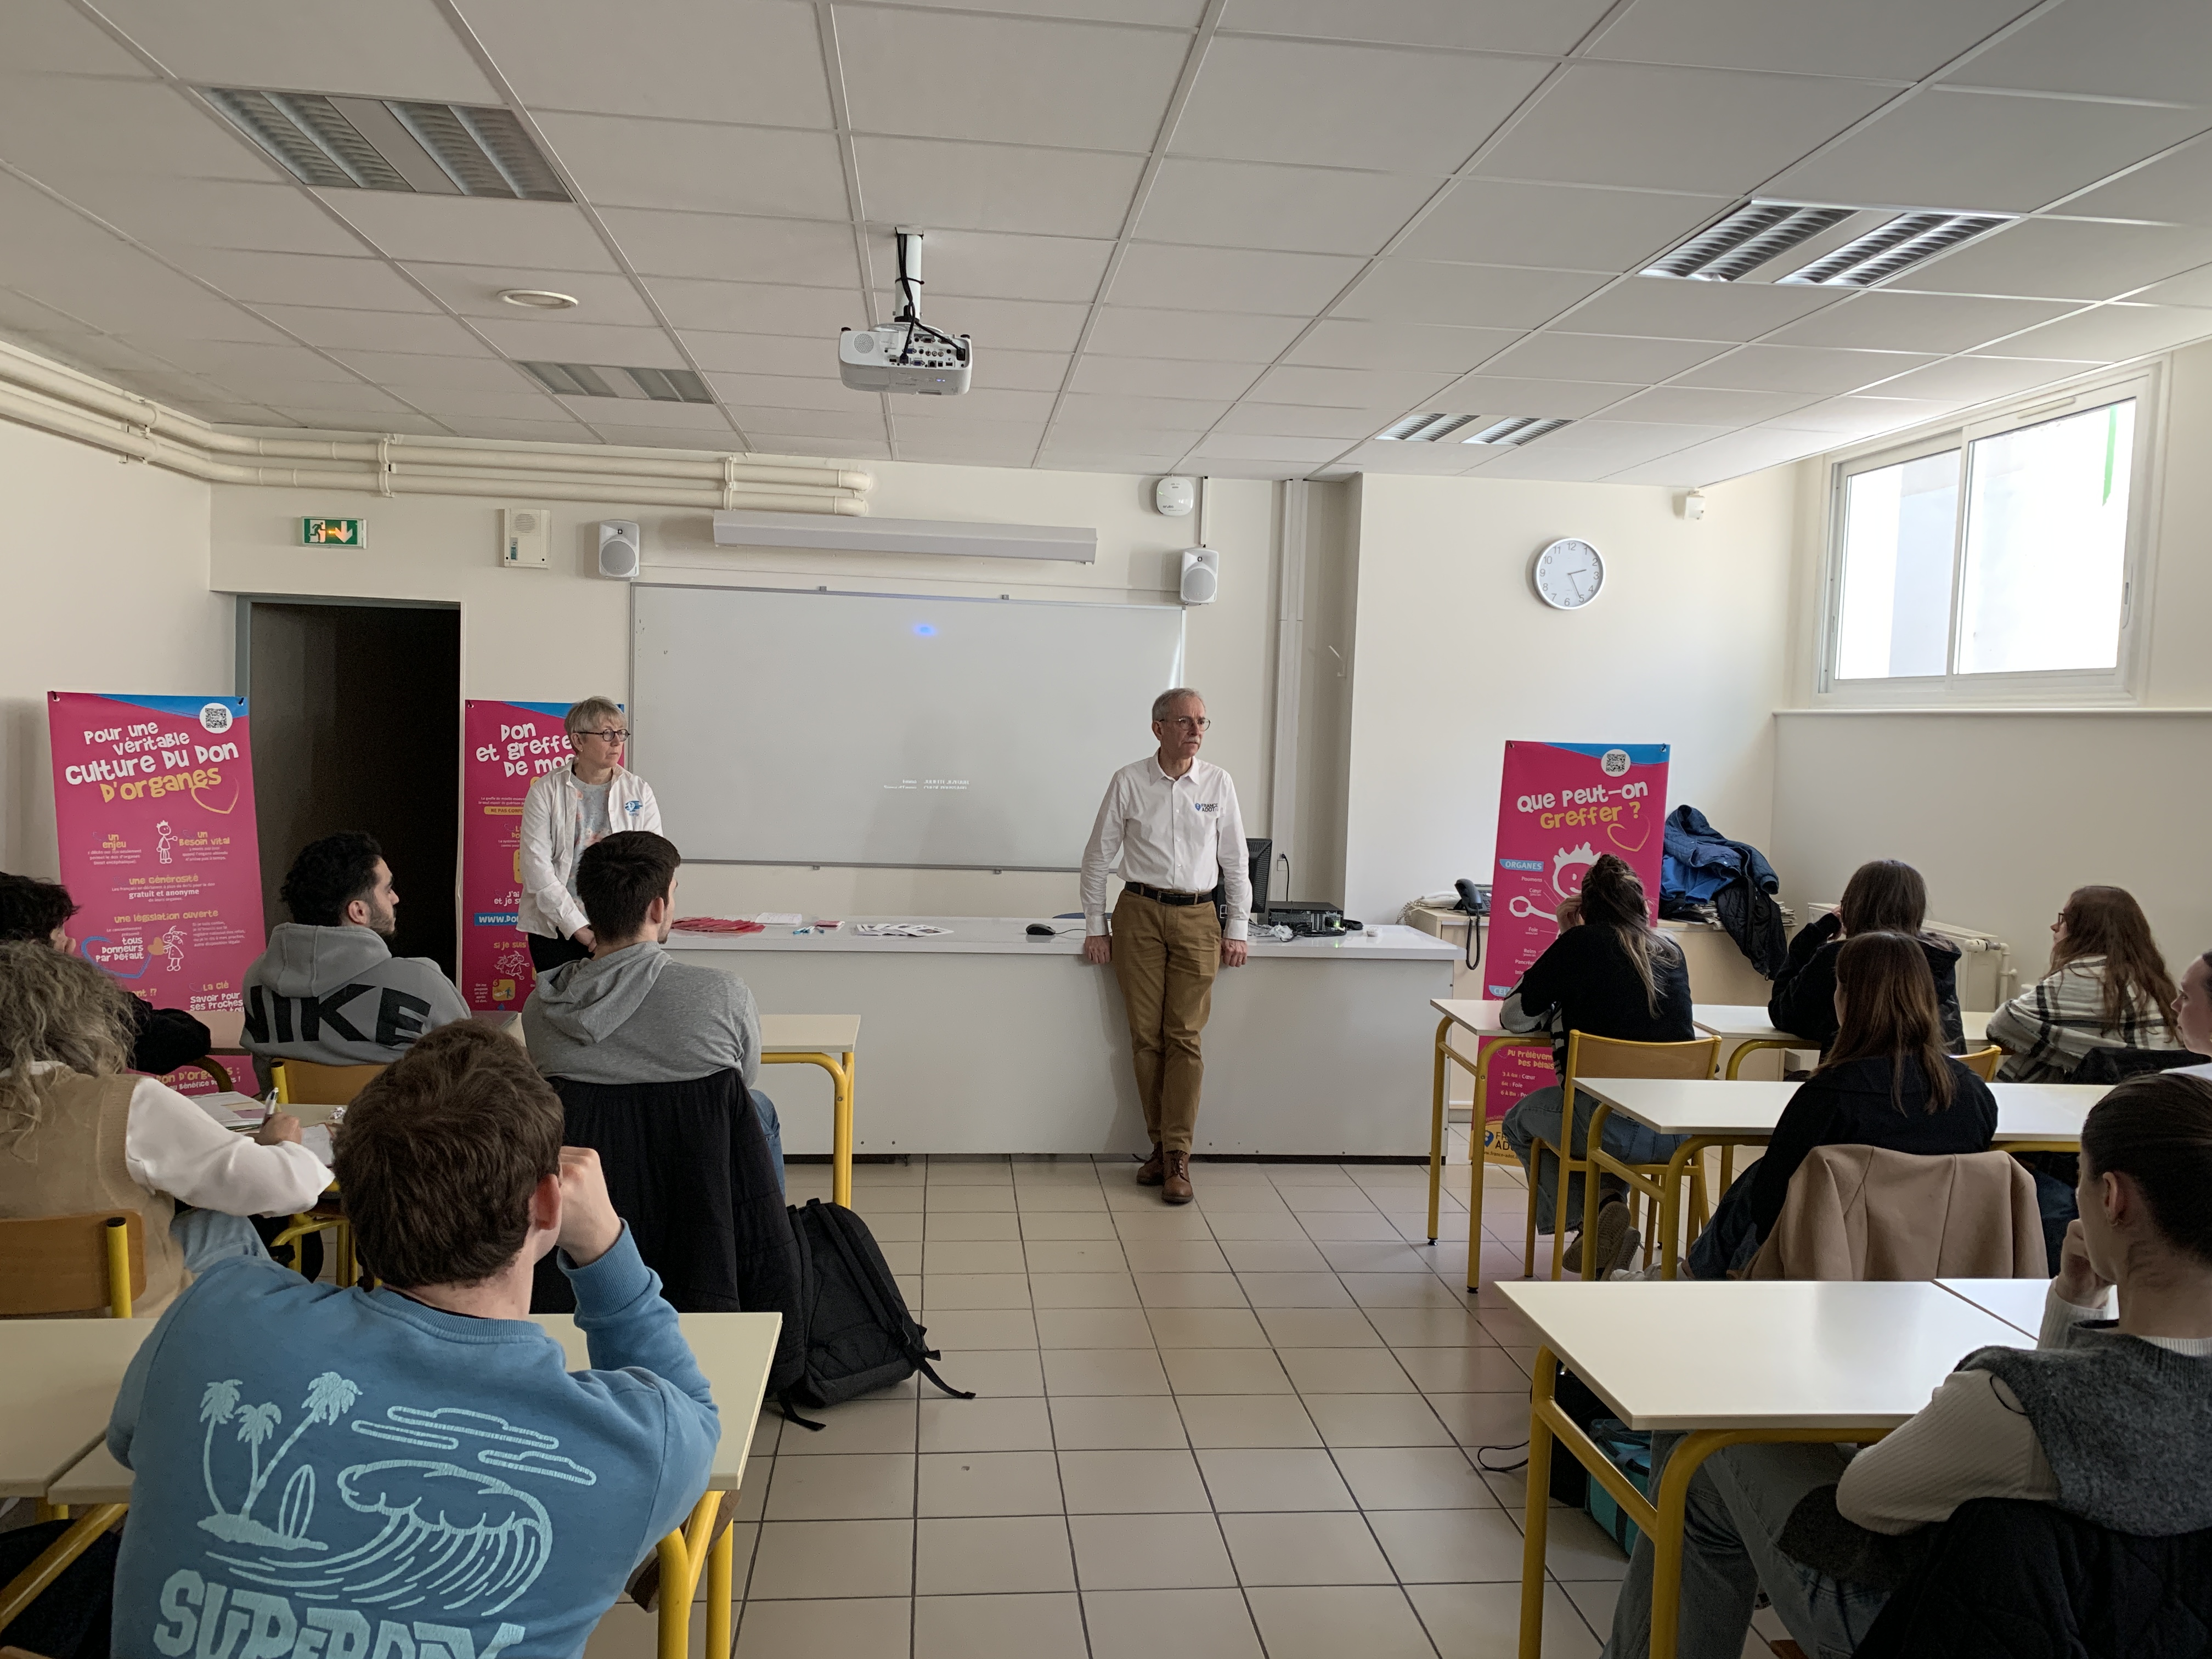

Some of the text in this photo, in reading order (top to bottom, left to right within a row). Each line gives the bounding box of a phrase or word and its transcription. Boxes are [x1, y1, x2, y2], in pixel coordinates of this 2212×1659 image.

[1553, 546, 1561, 554] 11
[1567, 543, 1576, 551] 12
[1544, 556, 1552, 564] 10
[1592, 558, 1598, 566] 2
[83, 721, 159, 744] Pour une
[501, 723, 537, 742] Don
[476, 735, 572, 762] et greffe
[65, 754, 156, 785] Culture
[1517, 793, 1556, 813] Que
[1540, 801, 1641, 829] Greffer ?
[103, 841, 126, 850] enjeu
[1505, 861, 1542, 870] ORGANES
[128, 890, 155, 900] gratuit
[166, 889, 199, 897] anonyme
[504, 898, 512, 907] je
[114, 910, 218, 924] une législation ouverte
[122, 937, 143, 945] tous
[1494, 988, 1506, 996] CEL
[1517, 1050, 1553, 1060] Prélèvem
